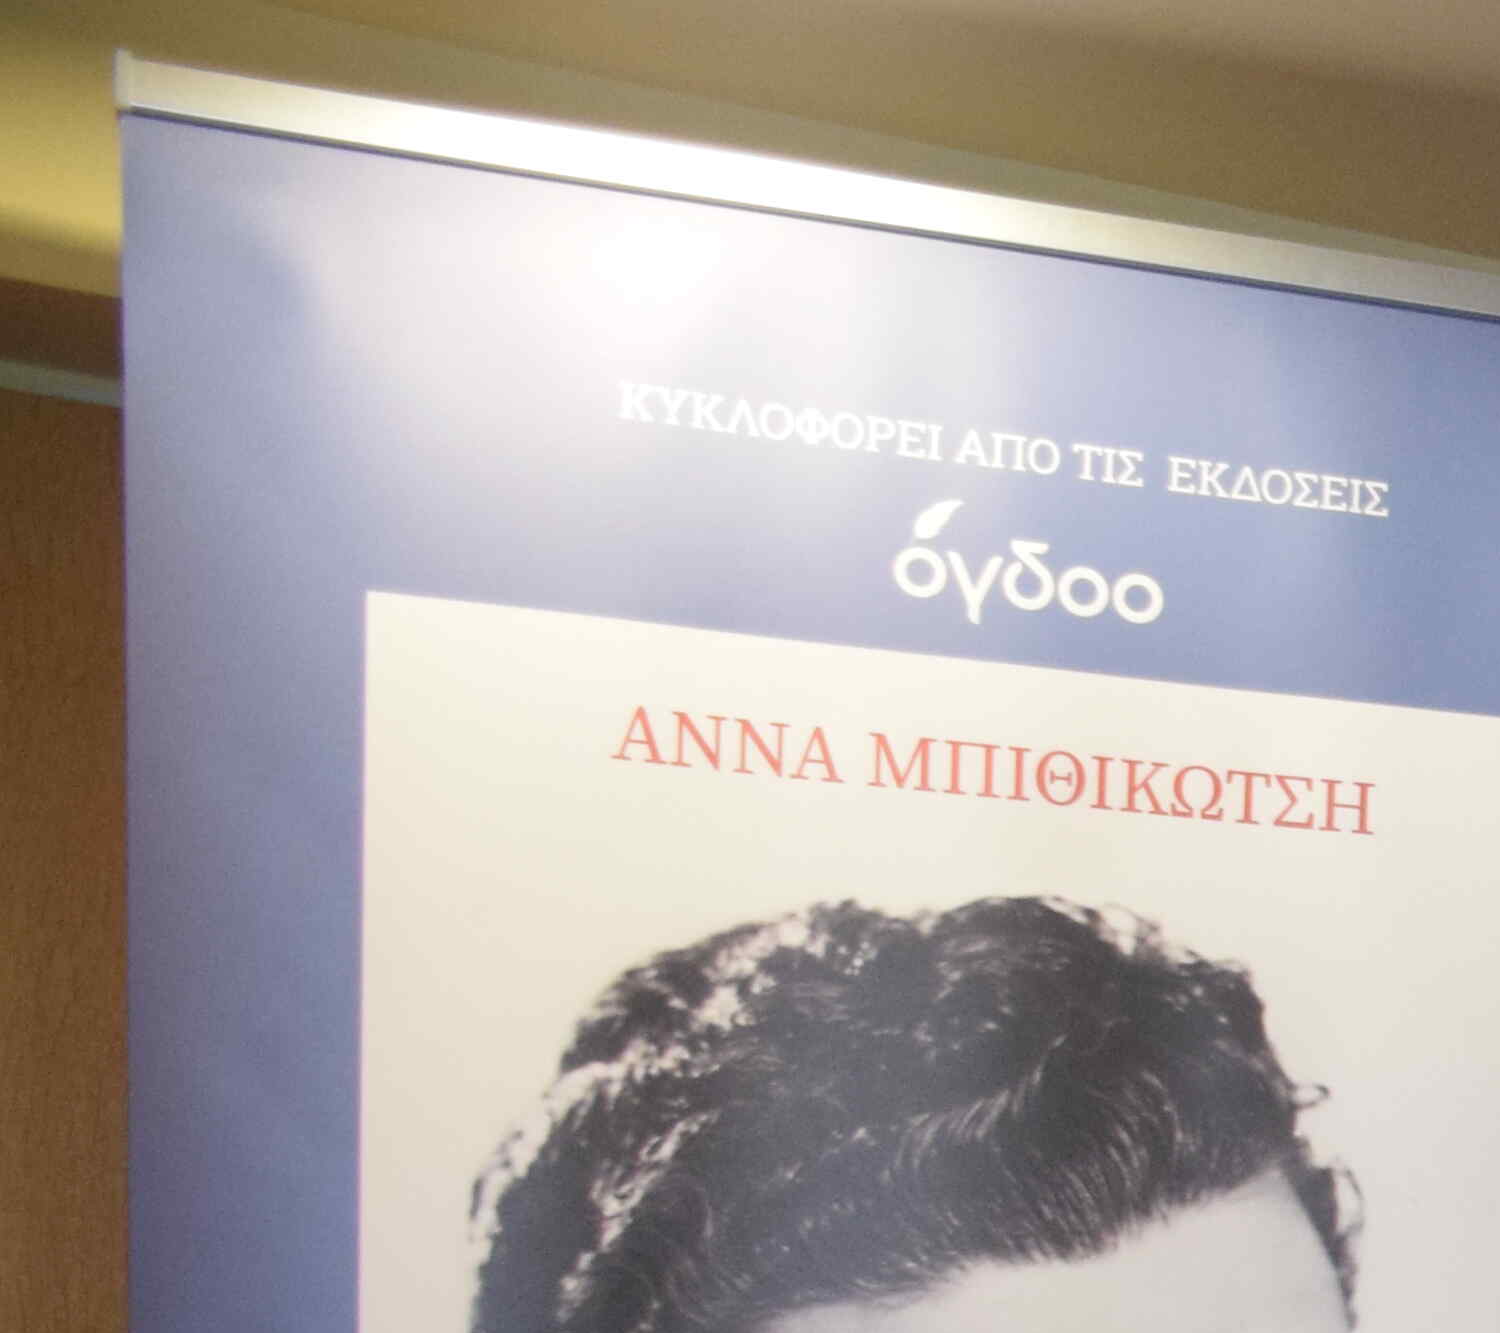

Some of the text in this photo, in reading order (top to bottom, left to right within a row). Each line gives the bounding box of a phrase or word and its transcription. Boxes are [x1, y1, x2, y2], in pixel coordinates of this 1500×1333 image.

[616, 380, 1391, 518] ΚΥΚΛΟΦΟΡΕΙ ΑΠΟ ΤΙΣ ΕΚΔΟΣΕΙΣ
[609, 704, 1377, 835] ΑΝΝΑ ΜΠΙΘΙΚΩΤΣΗ
